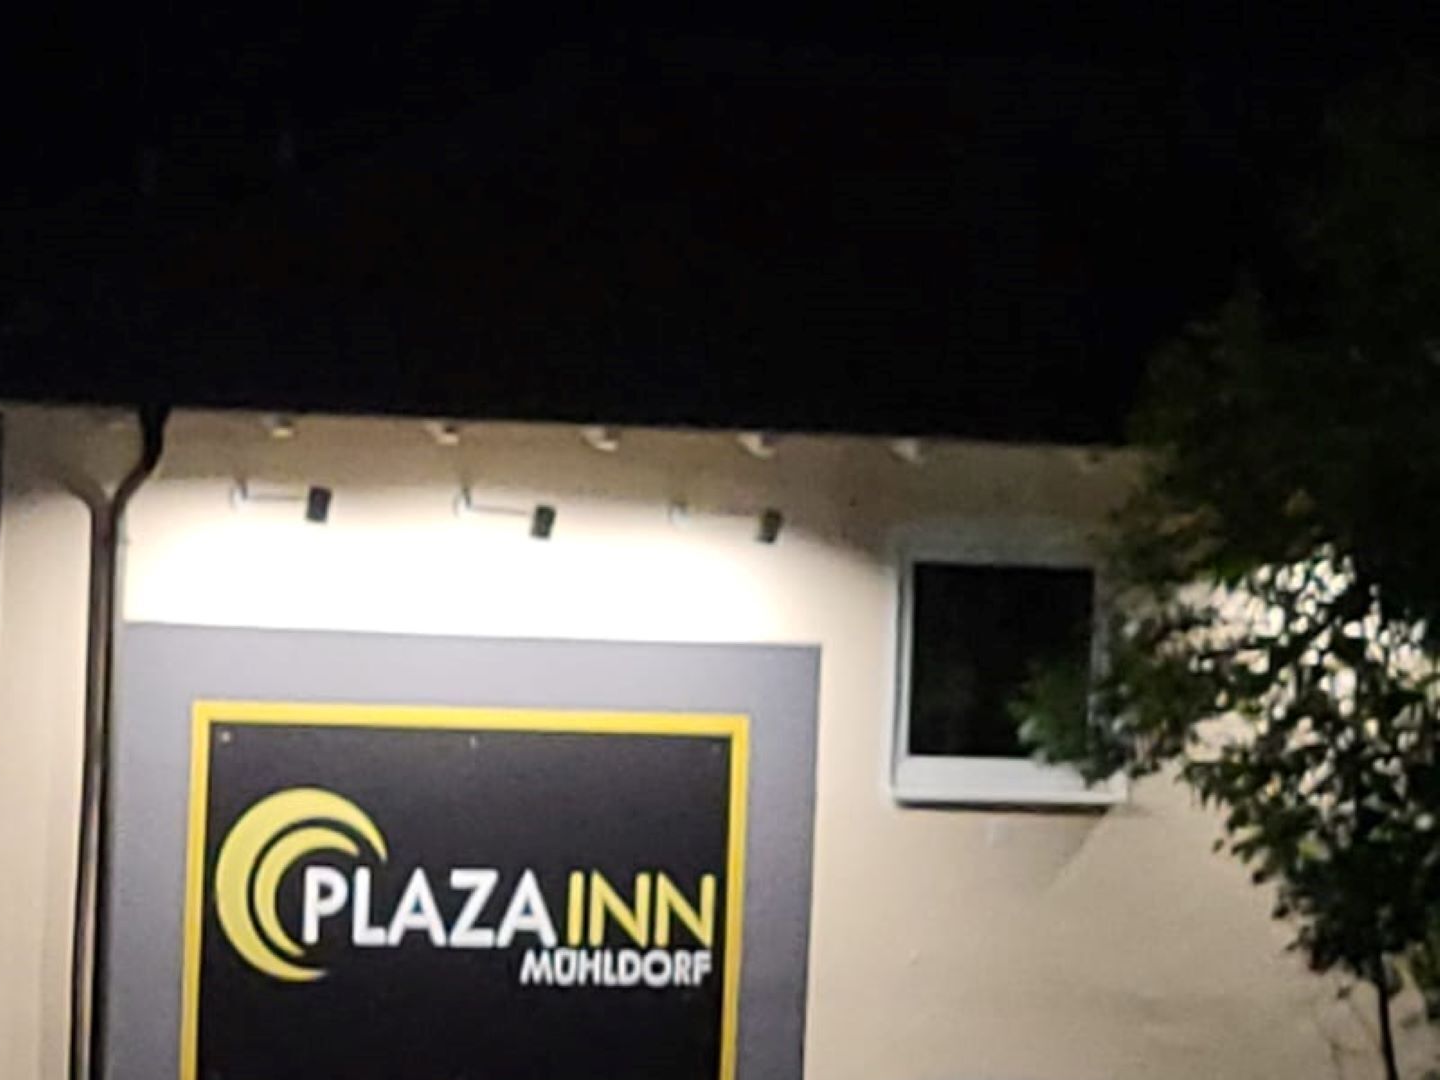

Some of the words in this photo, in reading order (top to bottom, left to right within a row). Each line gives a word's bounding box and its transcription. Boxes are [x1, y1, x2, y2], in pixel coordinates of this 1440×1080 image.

[302, 867, 558, 948] PLAZA
[566, 870, 715, 948] INN
[520, 948, 712, 987] MÜHLDORF
